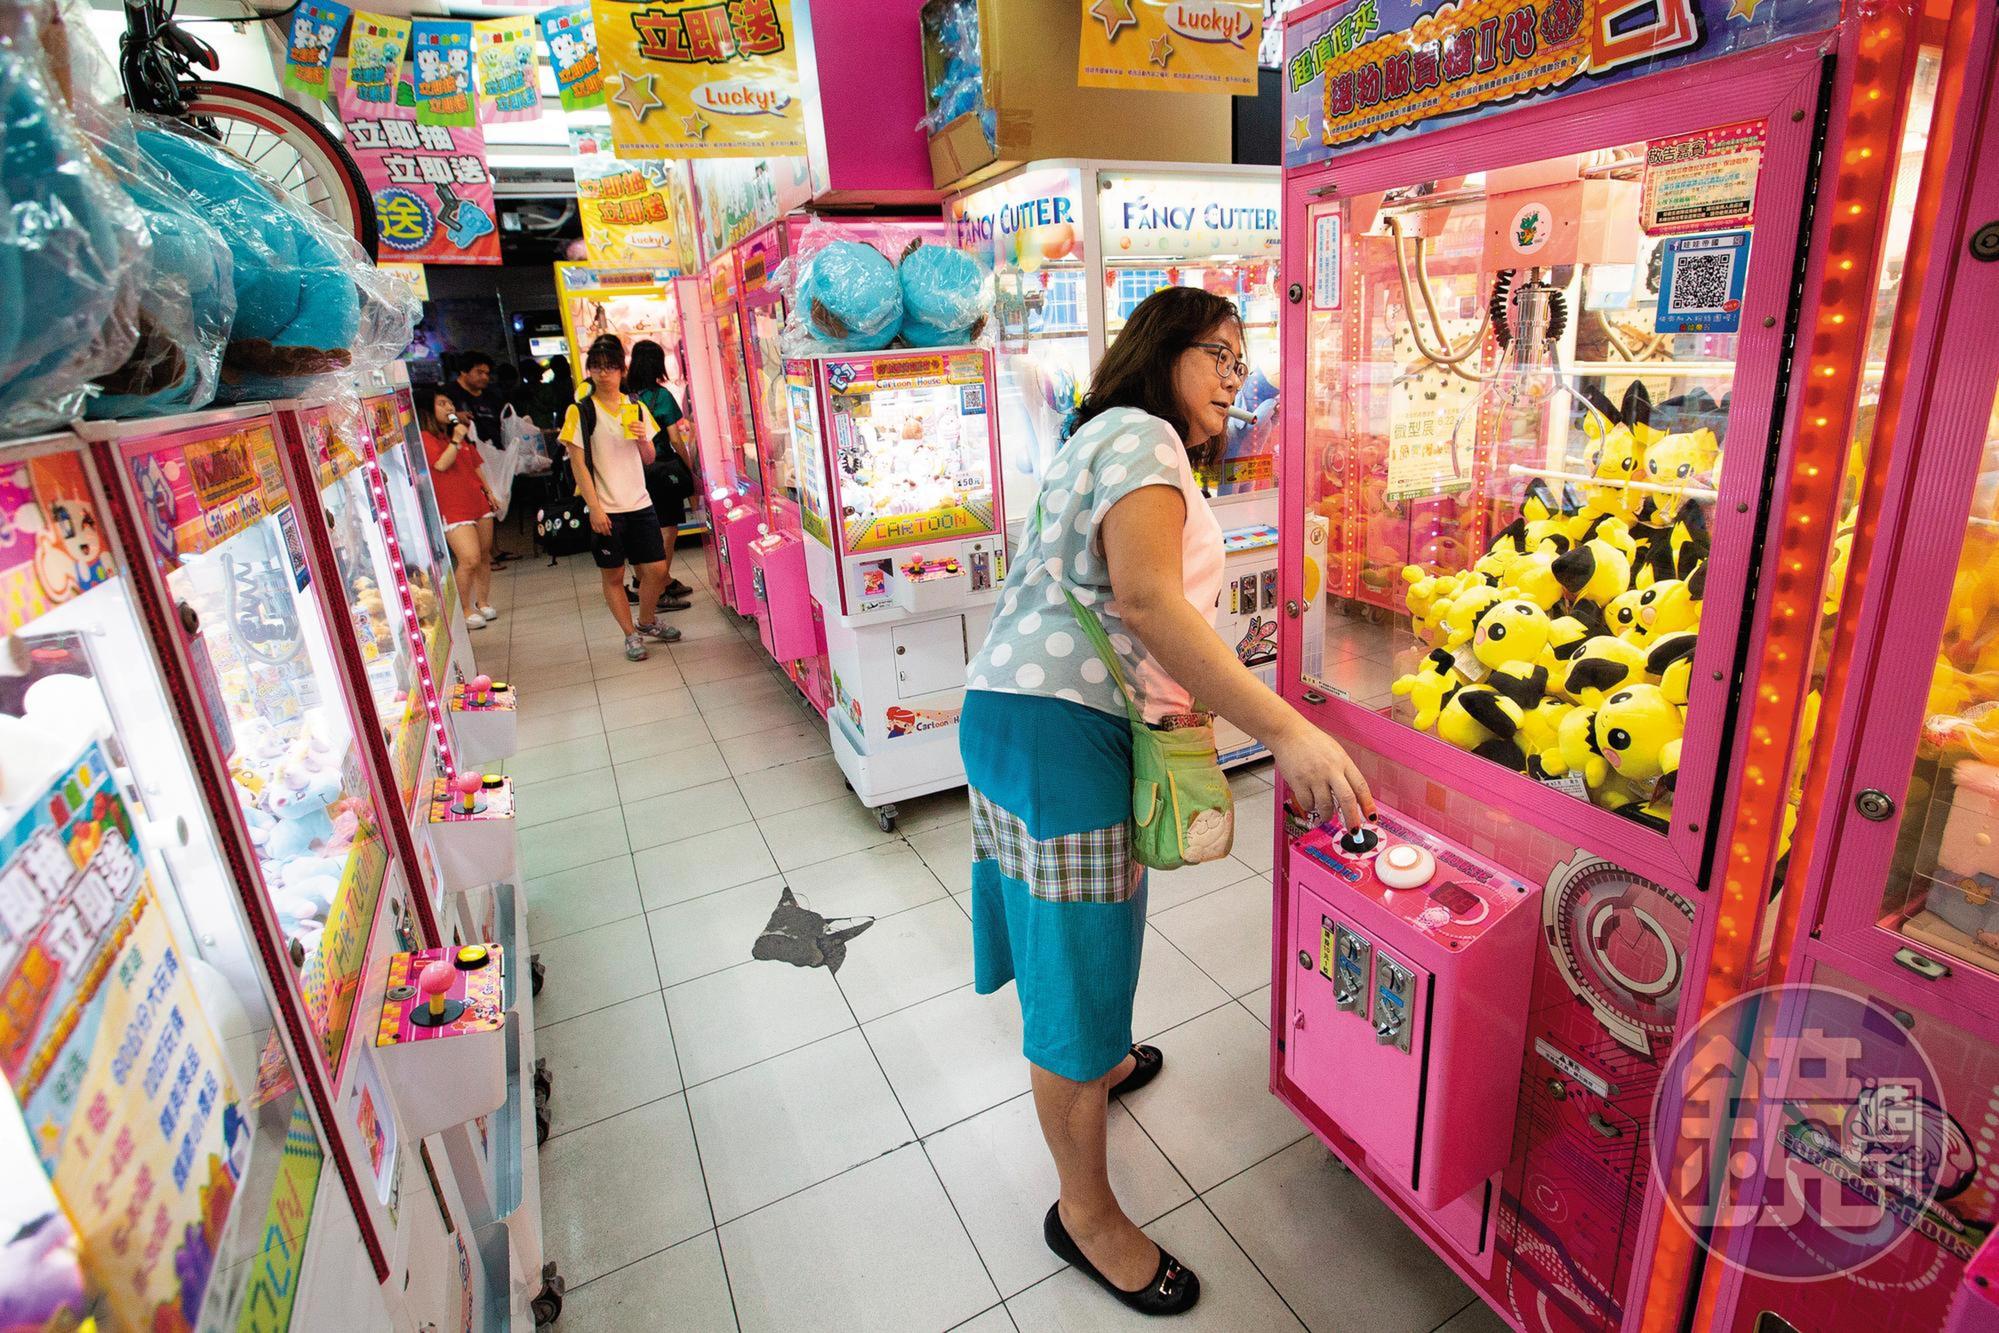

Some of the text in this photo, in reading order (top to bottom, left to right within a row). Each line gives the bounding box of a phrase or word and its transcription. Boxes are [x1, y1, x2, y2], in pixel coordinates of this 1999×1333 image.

[631, 0, 785, 64] 立即送
[1177, 6, 1241, 37] Lucky!
[705, 86, 777, 111] Lucky!
[345, 118, 457, 151] 立即抽
[1648, 139, 1707, 165] 敬告嘉賓
[381, 153, 487, 187] 立即送
[377, 197, 424, 239] 送
[597, 192, 668, 225] 立即送
[1001, 196, 1074, 236] CUTTER
[1122, 195, 1279, 231] FANCY CUTTER
[875, 513, 967, 540] CARTOON
[916, 717, 949, 732] Cartoon
